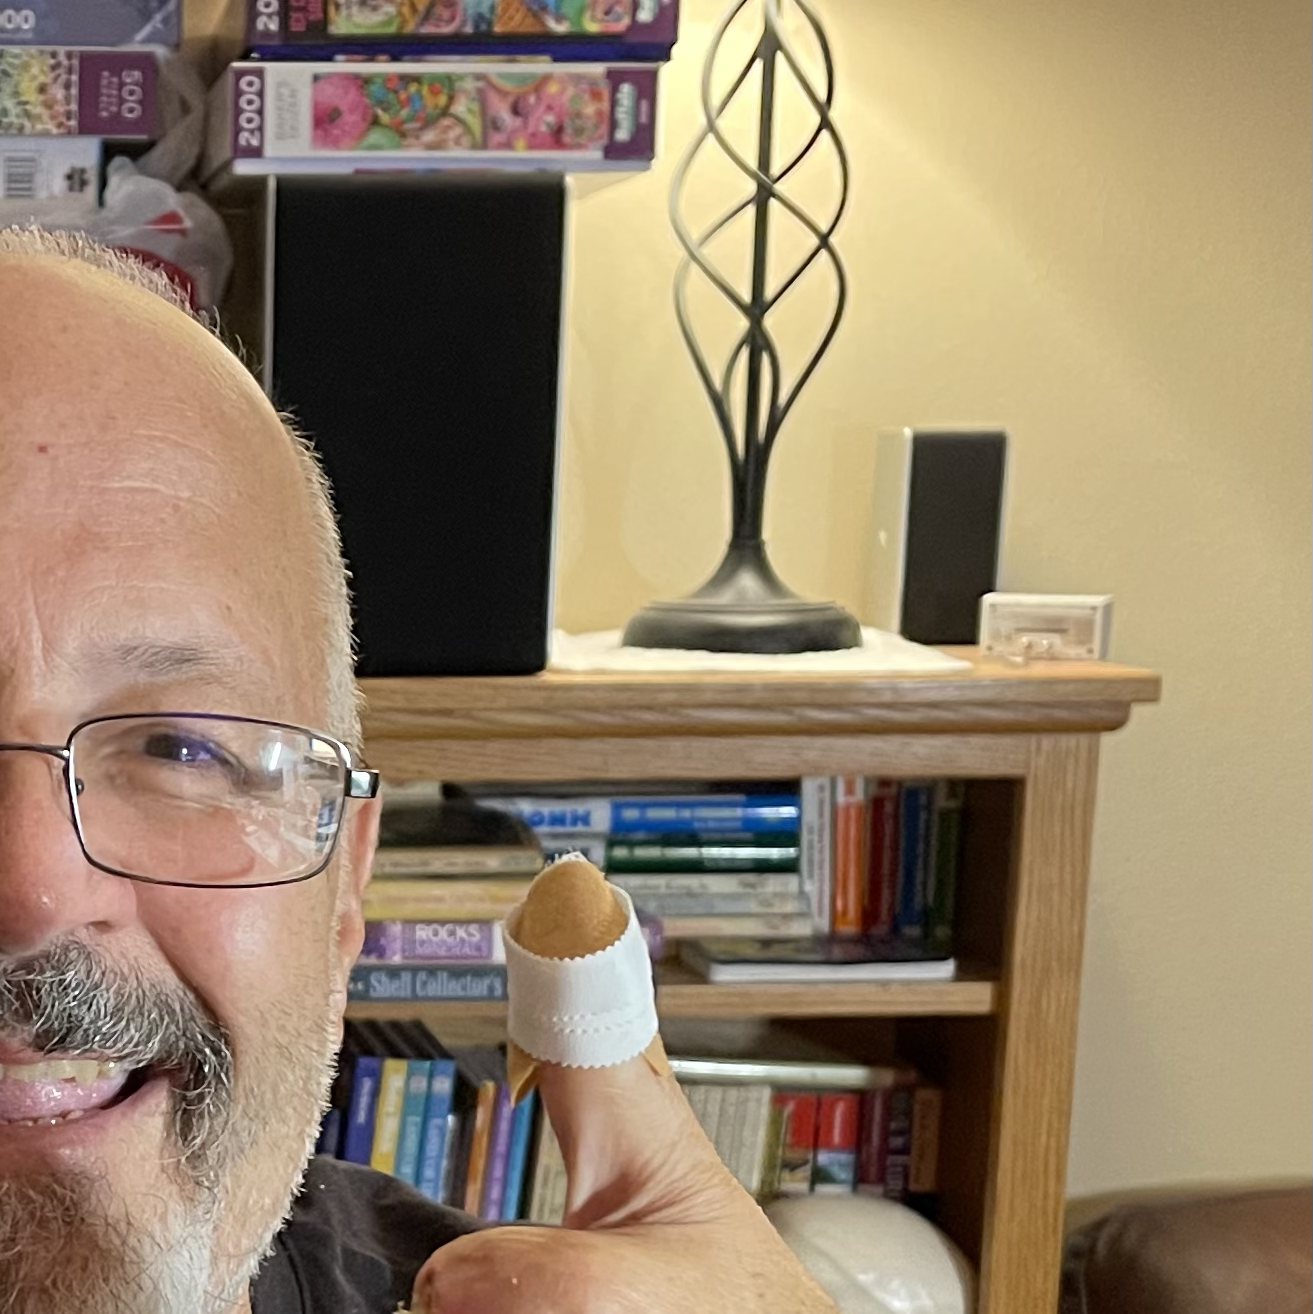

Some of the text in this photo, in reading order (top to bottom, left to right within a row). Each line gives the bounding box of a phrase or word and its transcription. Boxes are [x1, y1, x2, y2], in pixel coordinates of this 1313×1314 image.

[121, 69, 143, 118] 500
[238, 75, 262, 147] 2000
[415, 923, 481, 943] ROCKS
[369, 970, 503, 998] Shell Collector's
